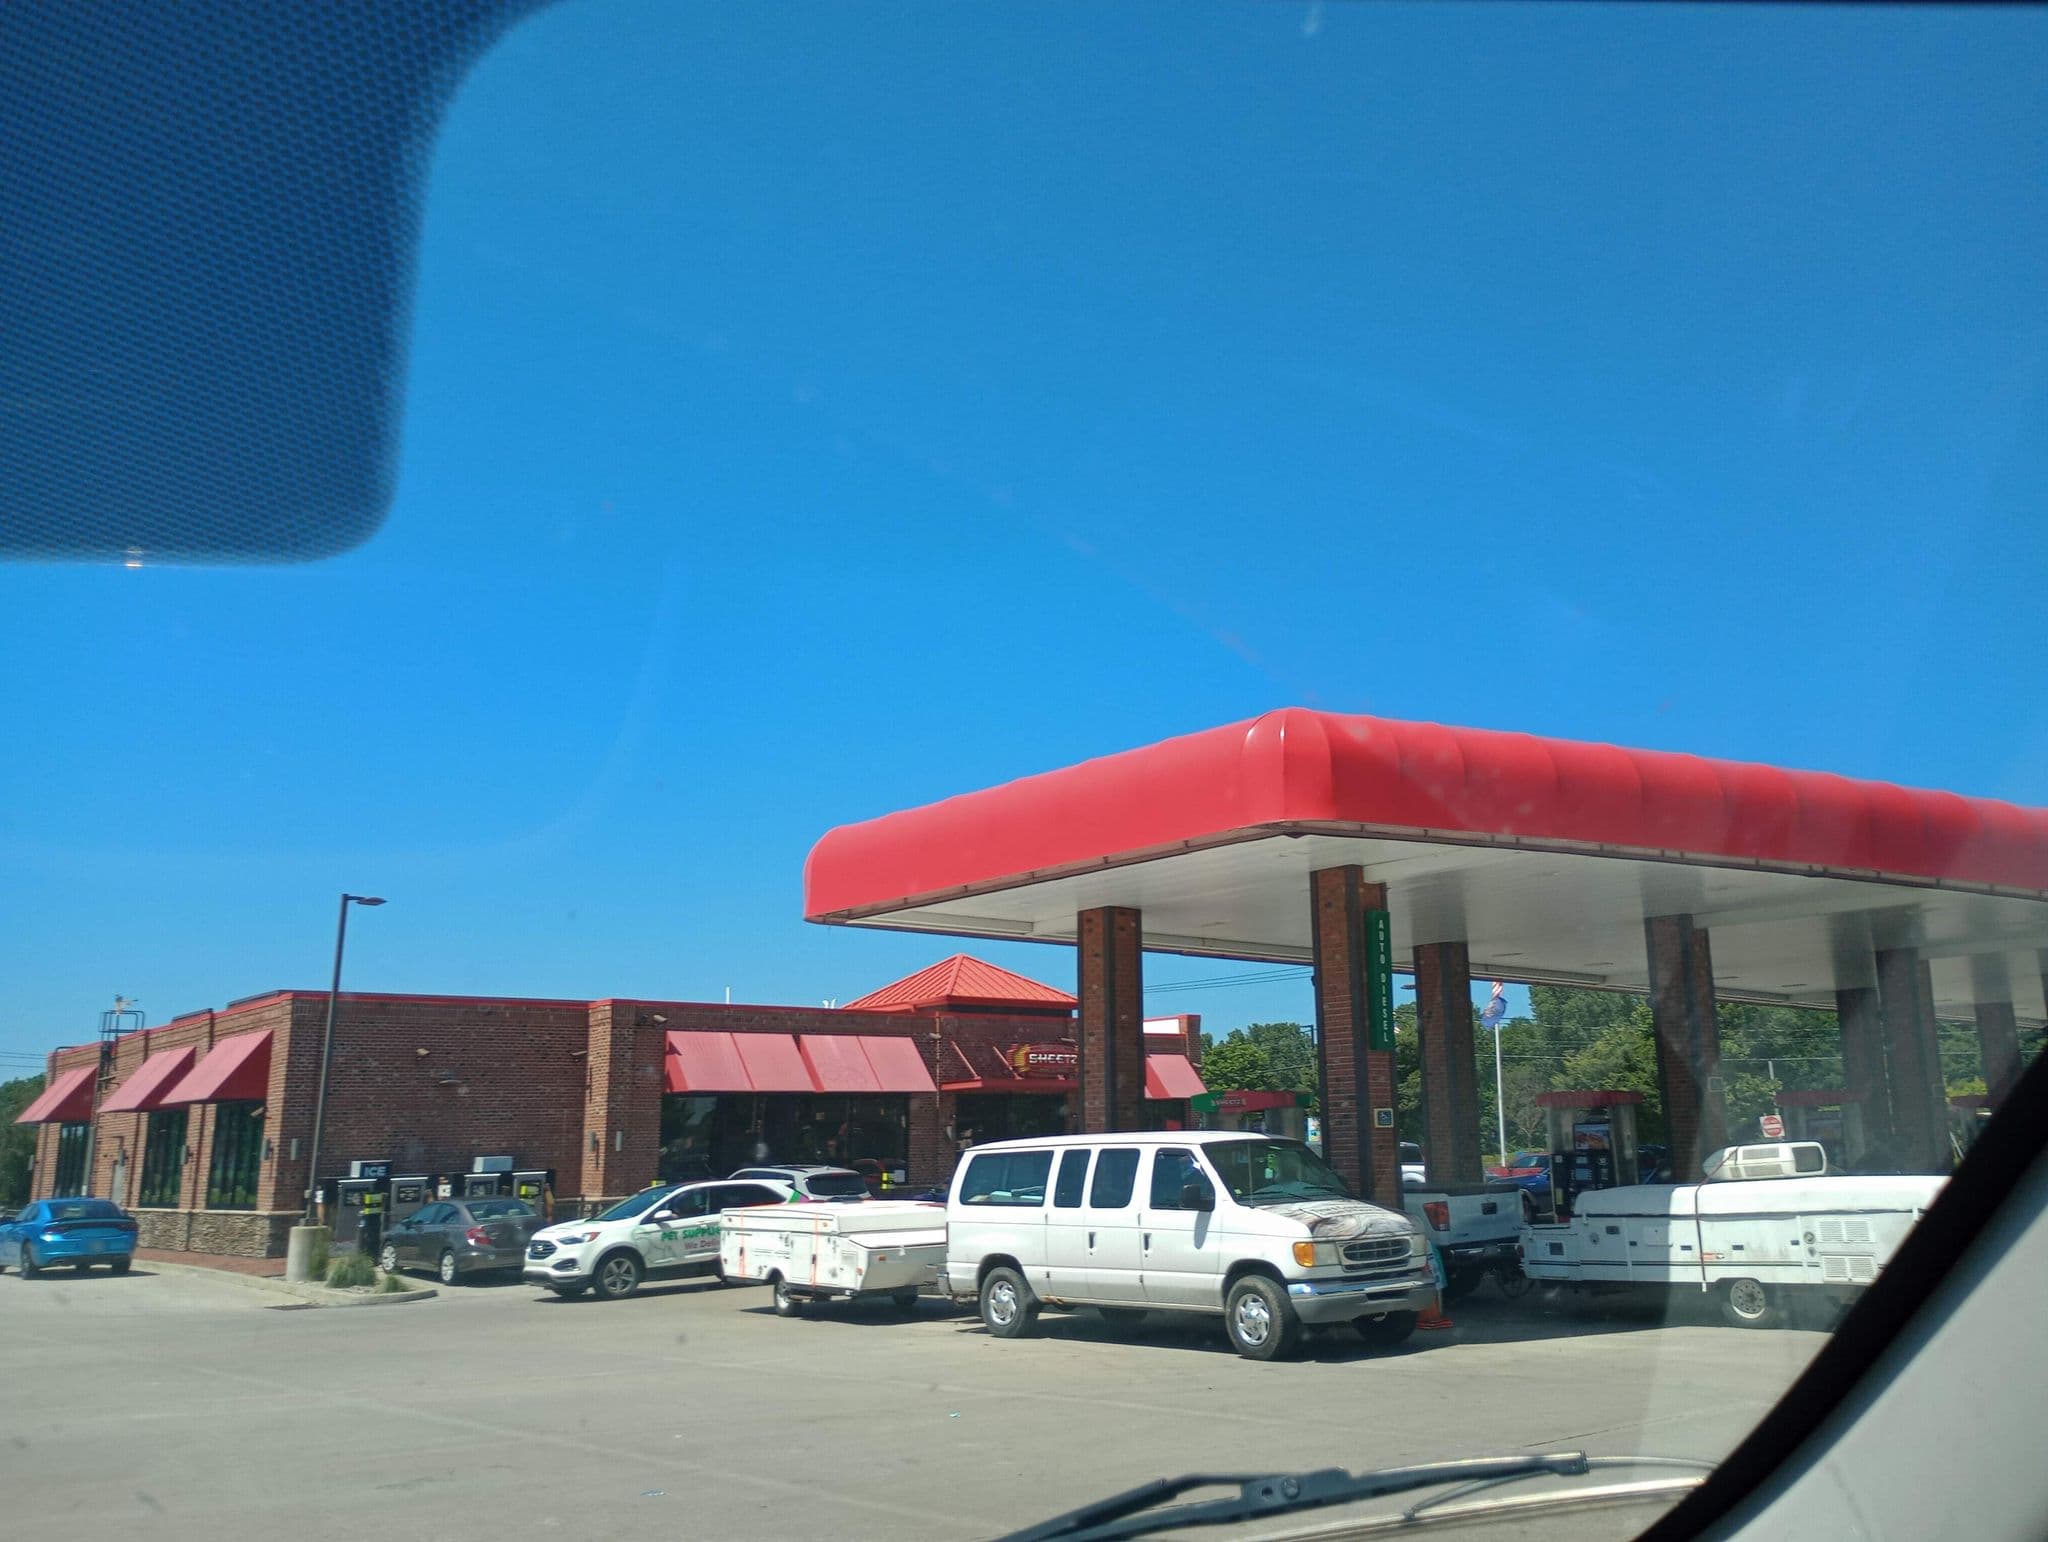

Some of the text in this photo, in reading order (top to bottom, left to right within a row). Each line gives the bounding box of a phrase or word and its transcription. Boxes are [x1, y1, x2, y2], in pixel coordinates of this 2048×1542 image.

[1380, 973, 1388, 1042] DIESEL
[1028, 1053, 1078, 1064] SHEETZ
[364, 1166, 386, 1177] ICE
[662, 1231, 678, 1241] PET
